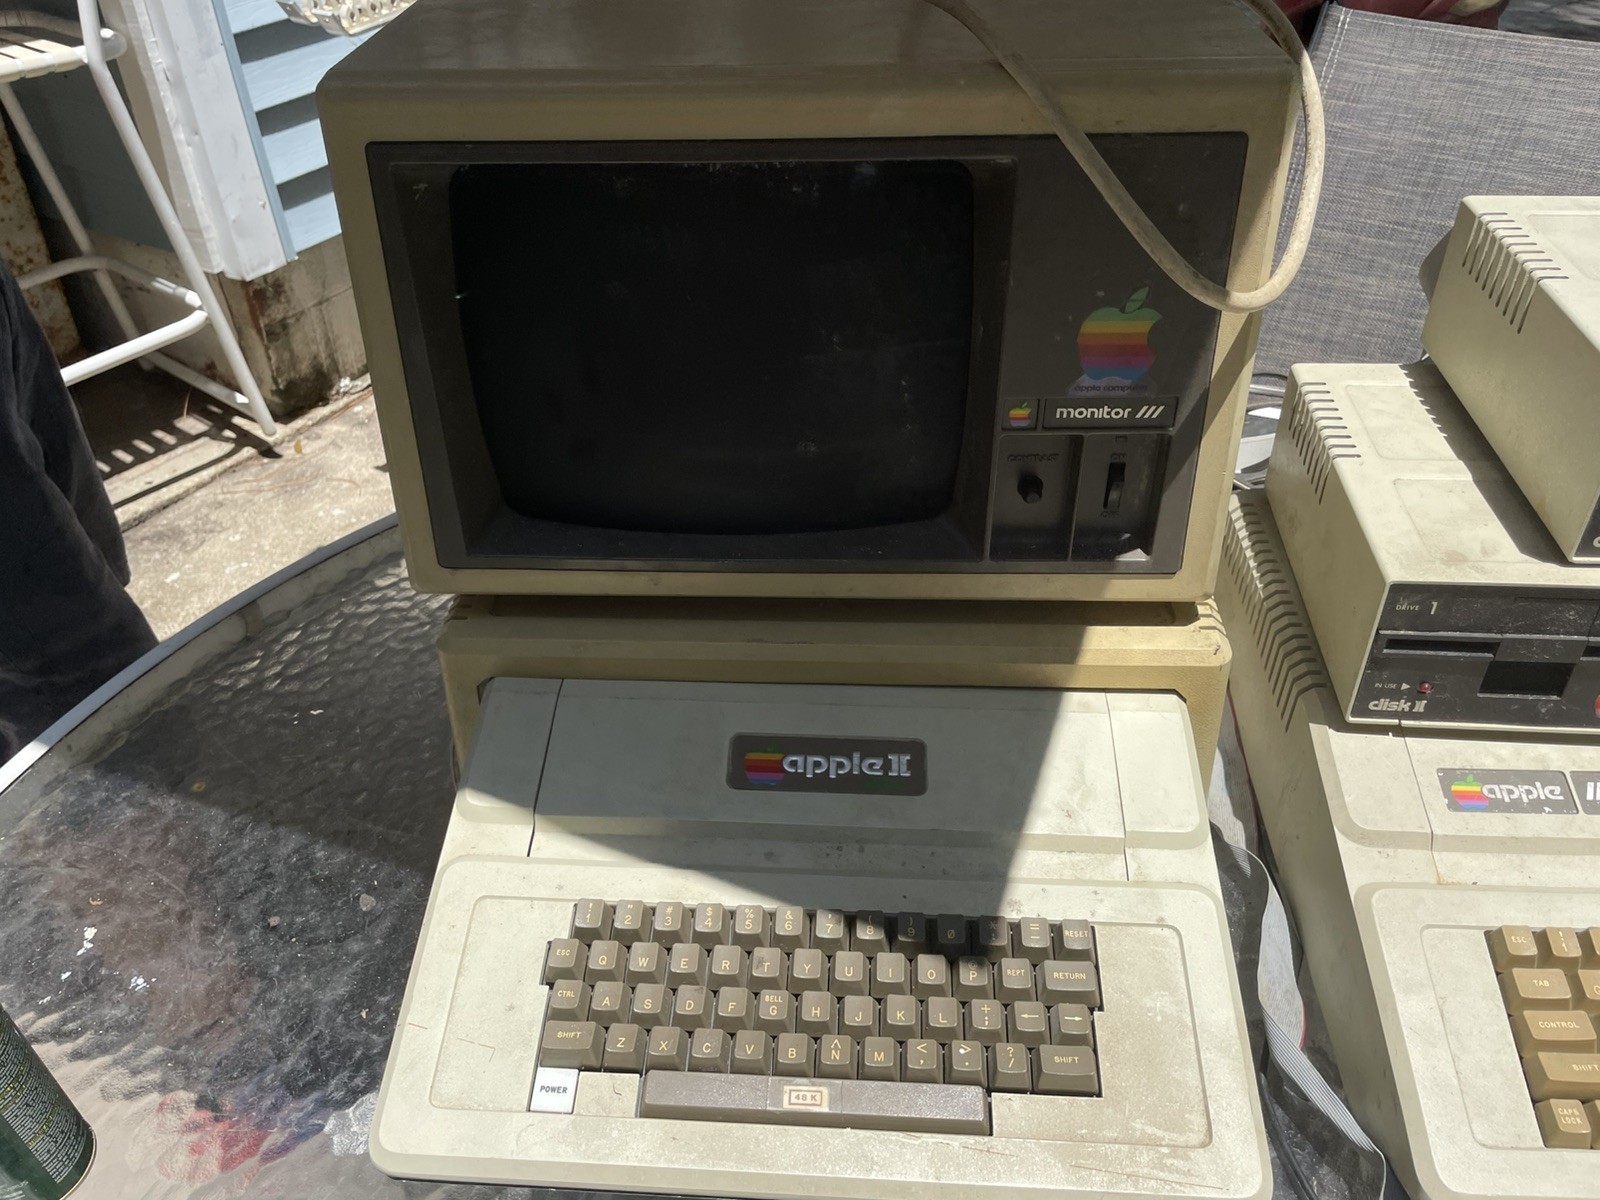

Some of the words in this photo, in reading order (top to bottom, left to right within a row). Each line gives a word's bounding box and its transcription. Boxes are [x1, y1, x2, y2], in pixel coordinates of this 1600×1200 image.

[1074, 385, 1101, 393] apple
[1056, 405, 1132, 419] monitor
[1430, 601, 1438, 615] 1
[1368, 699, 1411, 712] disk
[782, 752, 884, 778] apple
[1482, 782, 1564, 802] apple
[665, 906, 674, 916] #
[706, 907, 713, 916] $
[744, 908, 755, 919] %
[784, 910, 794, 920] &
[586, 914, 592, 923] 1
[624, 914, 632, 925] 2
[664, 916, 672, 926] 3
[704, 917, 713, 927] 4
[744, 919, 753, 930] 5
[784, 920, 793, 931] 6
[826, 923, 834, 934] 7
[866, 925, 874, 935] 8
[907, 927, 915, 937] 9
[1064, 929, 1089, 938] RESET
[556, 948, 571, 956] ESC
[598, 955, 608, 966] Q
[638, 958, 650, 968] W
[680, 959, 689, 969] E
[721, 960, 730, 970] R
[762, 962, 771, 972] T
[803, 963, 811, 973] Y
[844, 966, 854, 977] U
[969, 971, 978, 981] P
[1006, 968, 1025, 977] REPT
[1053, 971, 1087, 980] RETURN
[557, 990, 575, 998] CTRL
[764, 995, 783, 1003] BELL
[601, 997, 611, 1007] A
[643, 999, 652, 1009] S
[685, 1000, 694, 1011] D
[728, 1002, 737, 1012] F
[769, 1005, 778, 1016] G
[811, 1007, 820, 1017] H
[980, 1004, 991, 1014] +
[854, 1011, 862, 1022] J
[896, 1010, 906, 1021] K
[939, 1013, 948, 1023] L
[1538, 1021, 1580, 1029] CONTROL
[556, 1031, 582, 1039] SHIFT
[616, 1037, 626, 1048] Z
[659, 1041, 668, 1051] X
[702, 1043, 712, 1053] C
[745, 1044, 755, 1055] V
[787, 1048, 797, 1058] B
[916, 1043, 928, 1054] <
[1006, 1046, 1014, 1057] ?
[831, 1050, 840, 1061] N
[874, 1051, 885, 1062] M
[1054, 1055, 1079, 1064] SHIFT
[1008, 1058, 1015, 1068] /
[539, 1085, 568, 1094] POWER
[795, 1093, 807, 1102] 48
[811, 1094, 817, 1102] K
[1561, 1116, 1583, 1125] LOCK
